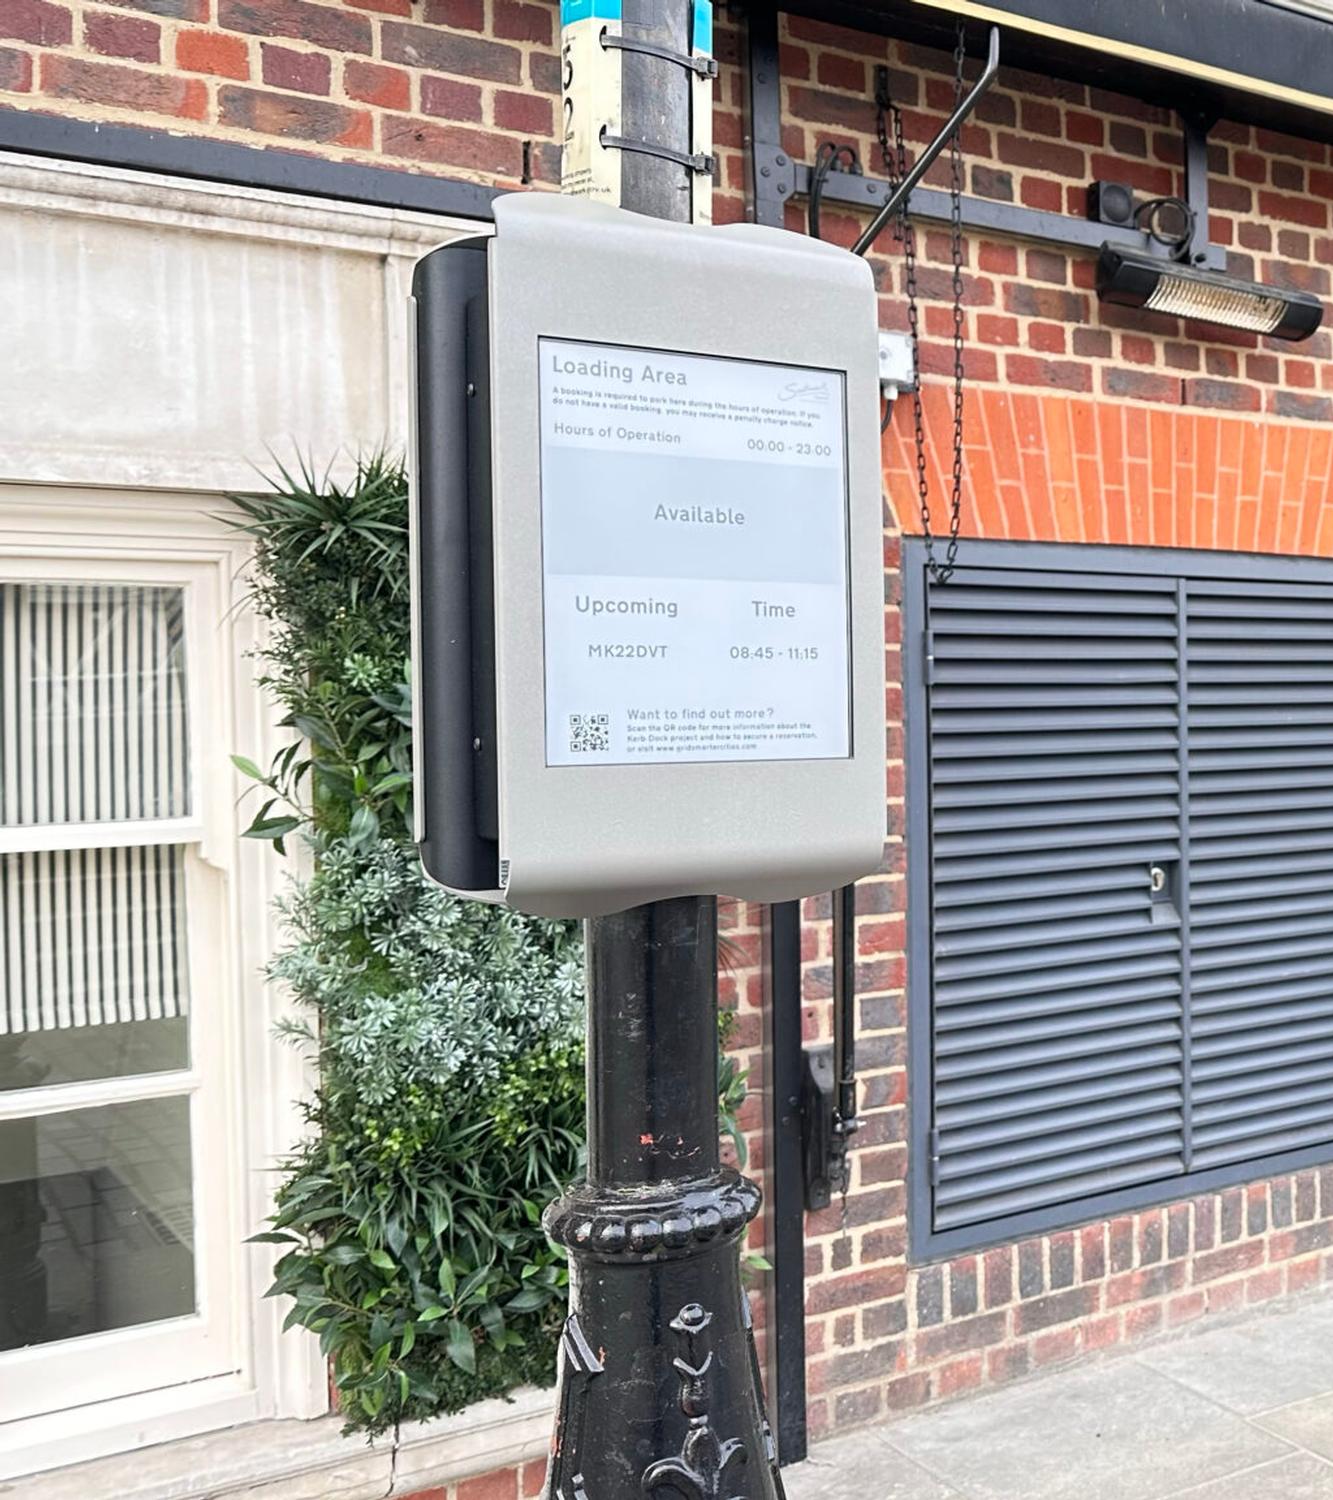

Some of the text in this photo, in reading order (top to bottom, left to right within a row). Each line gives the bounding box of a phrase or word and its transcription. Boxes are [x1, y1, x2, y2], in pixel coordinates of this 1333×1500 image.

[553, 355, 687, 385] Loading Area
[561, 387, 593, 398] booking
[604, 392, 637, 402] required
[650, 396, 667, 405] park
[669, 397, 686, 406] here
[688, 399, 713, 409] during
[715, 401, 727, 410] the
[729, 404, 750, 412] hours
[552, 397, 563, 405] do
[565, 398, 579, 406] not
[581, 399, 600, 407] have
[609, 402, 628, 410] valid
[666, 408, 680, 416] you
[682, 409, 697, 418] may
[699, 411, 726, 420] receive
[734, 414, 762, 424] penalty
[763, 416, 788, 426] charge
[554, 422, 681, 443] Hours of Operation
[654, 504, 745, 525] Available
[575, 595, 678, 618] Upcoming
[752, 600, 796, 617] Time
[588, 645, 668, 658] MK22DVT
[627, 707, 774, 720] Want to find out more?
[627, 724, 646, 732] Scan
[648, 724, 661, 732] the
[664, 723, 676, 732] QR
[678, 724, 696, 732] code
[733, 723, 775, 731] information
[777, 722, 797, 730] about
[799, 722, 811, 730] the
[670, 733, 698, 744] project
[700, 733, 714, 741] and
[716, 733, 731, 741] how
